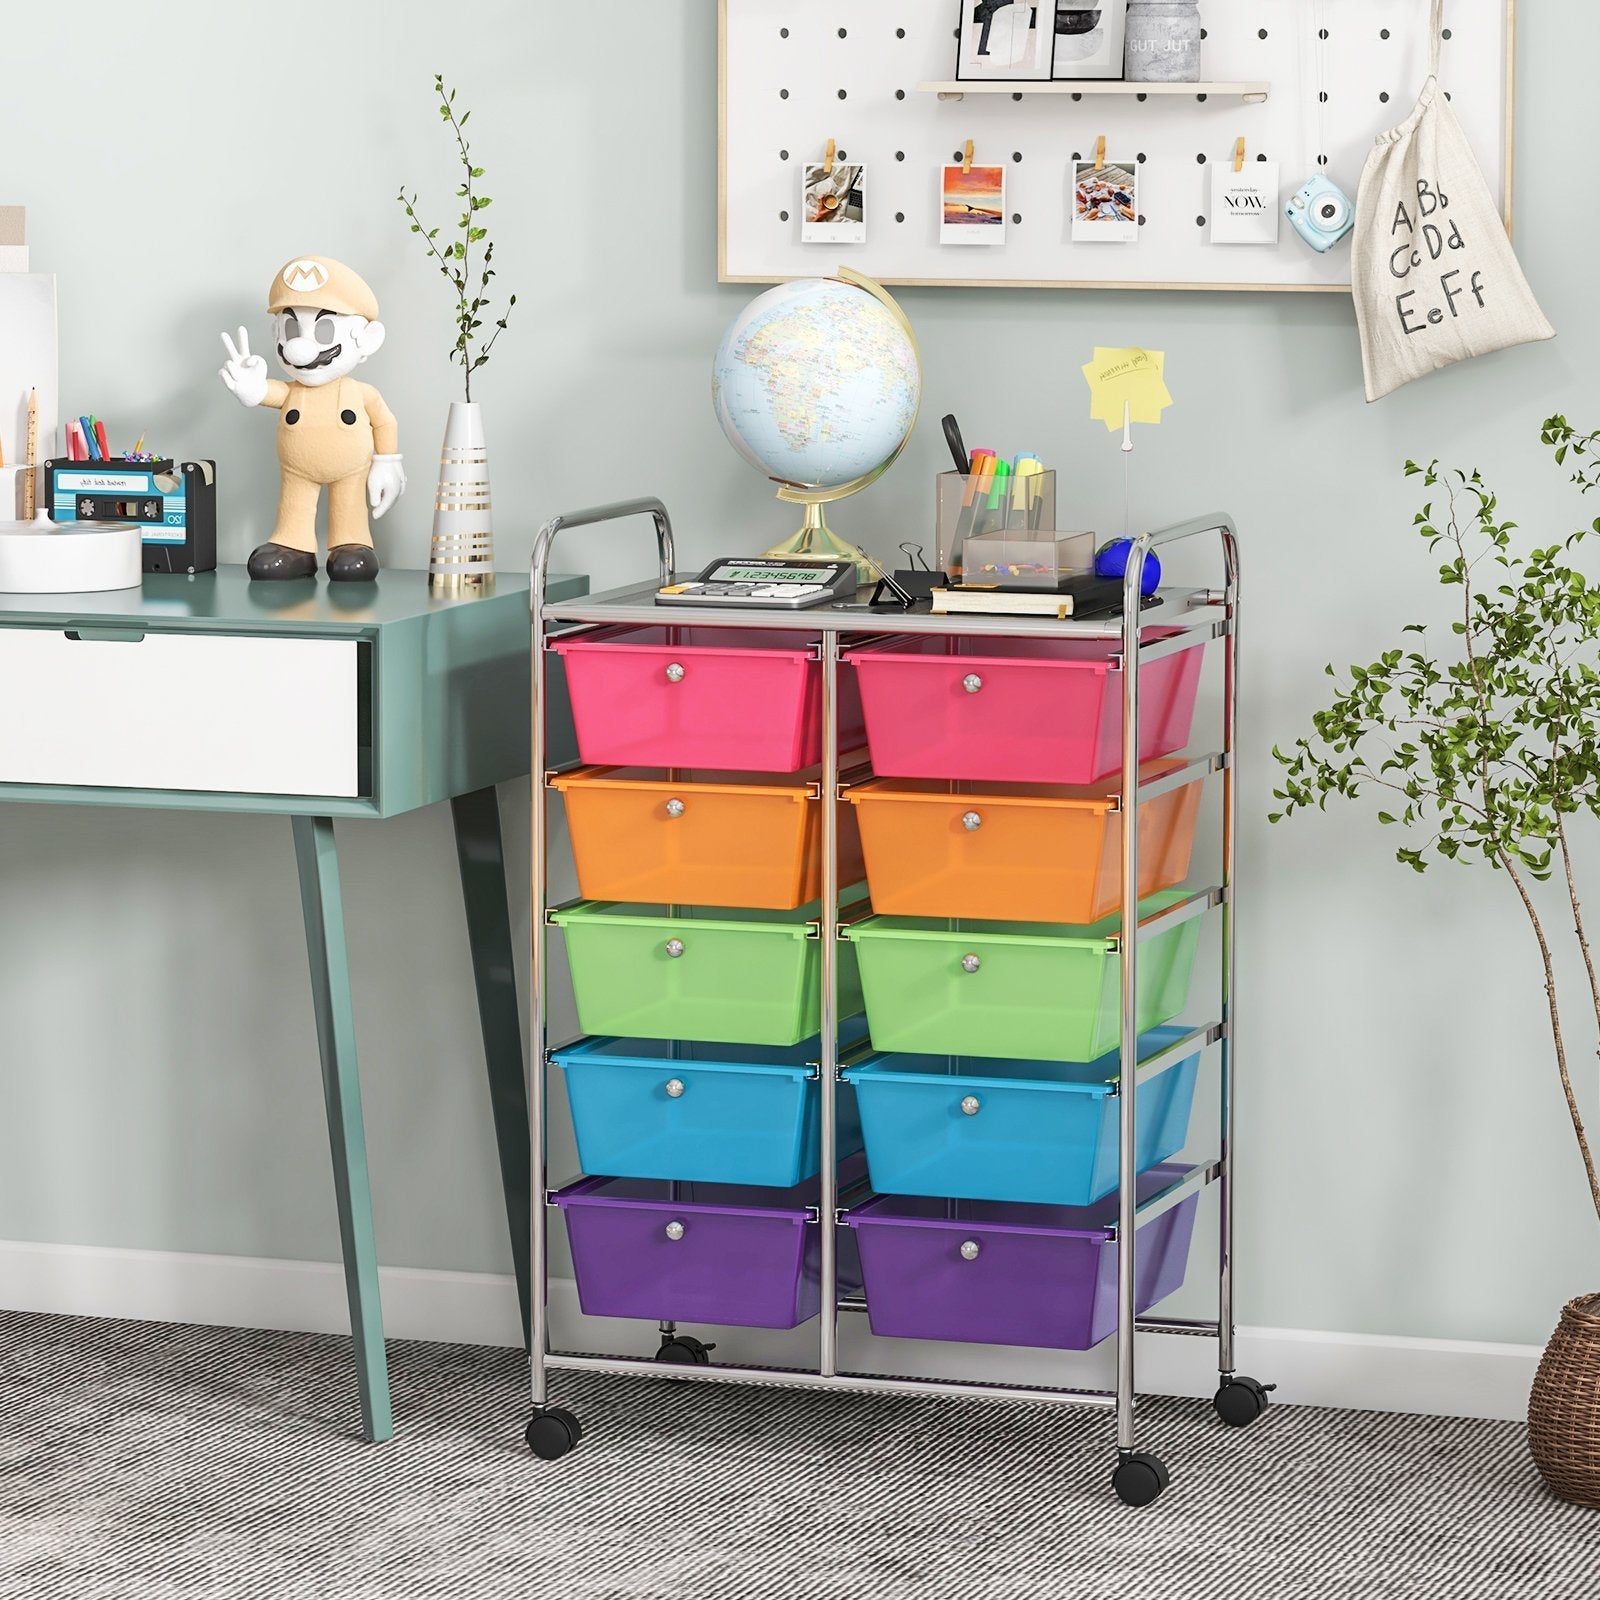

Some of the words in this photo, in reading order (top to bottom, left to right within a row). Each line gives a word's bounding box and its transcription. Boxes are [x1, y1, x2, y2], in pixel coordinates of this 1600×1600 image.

[1130, 39, 1157, 52] GUT
[1163, 39, 1191, 52] JUT
[1224, 196, 1267, 209] NOW.
[1391, 201, 1416, 236] A
[286, 265, 325, 286] M
